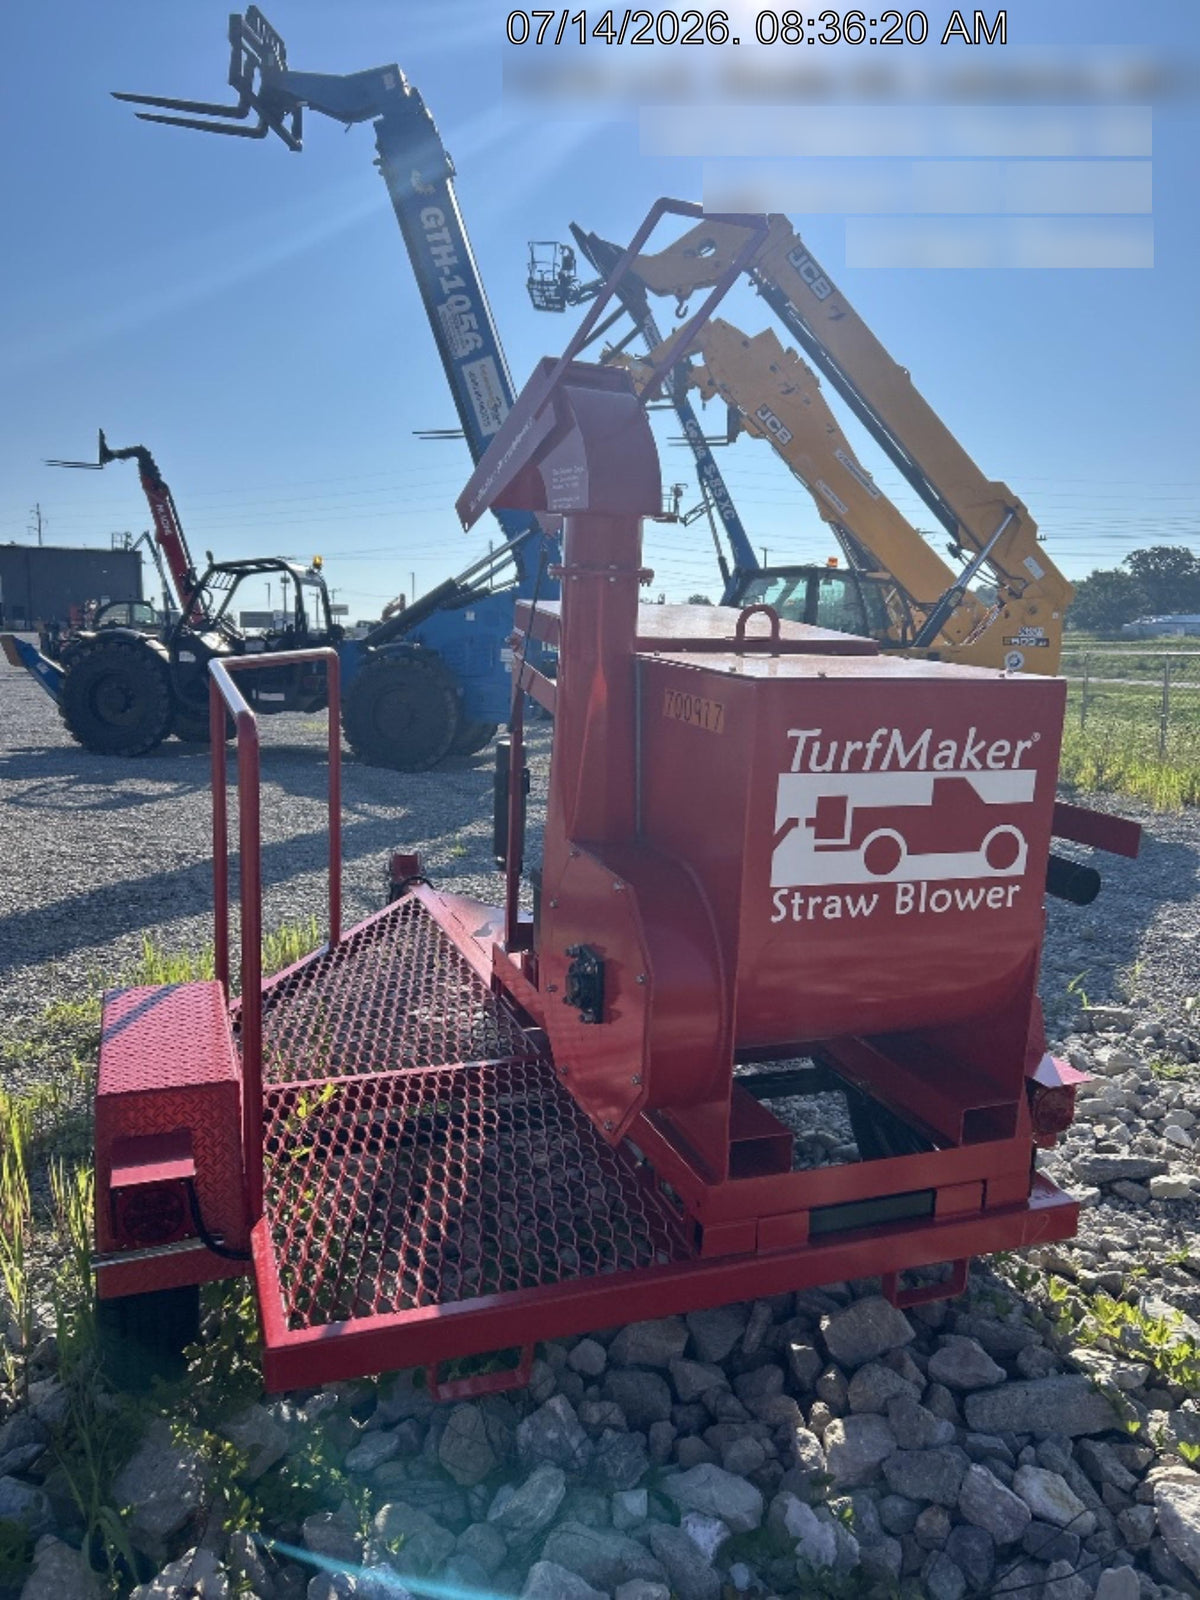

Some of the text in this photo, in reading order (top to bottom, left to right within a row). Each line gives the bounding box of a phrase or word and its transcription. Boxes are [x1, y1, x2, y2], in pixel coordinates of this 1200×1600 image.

[419, 207, 484, 357] GTH-1056
[788, 250, 832, 300] JCB
[756, 408, 792, 445] JCB
[770, 882, 1021, 923] Straw Blower
